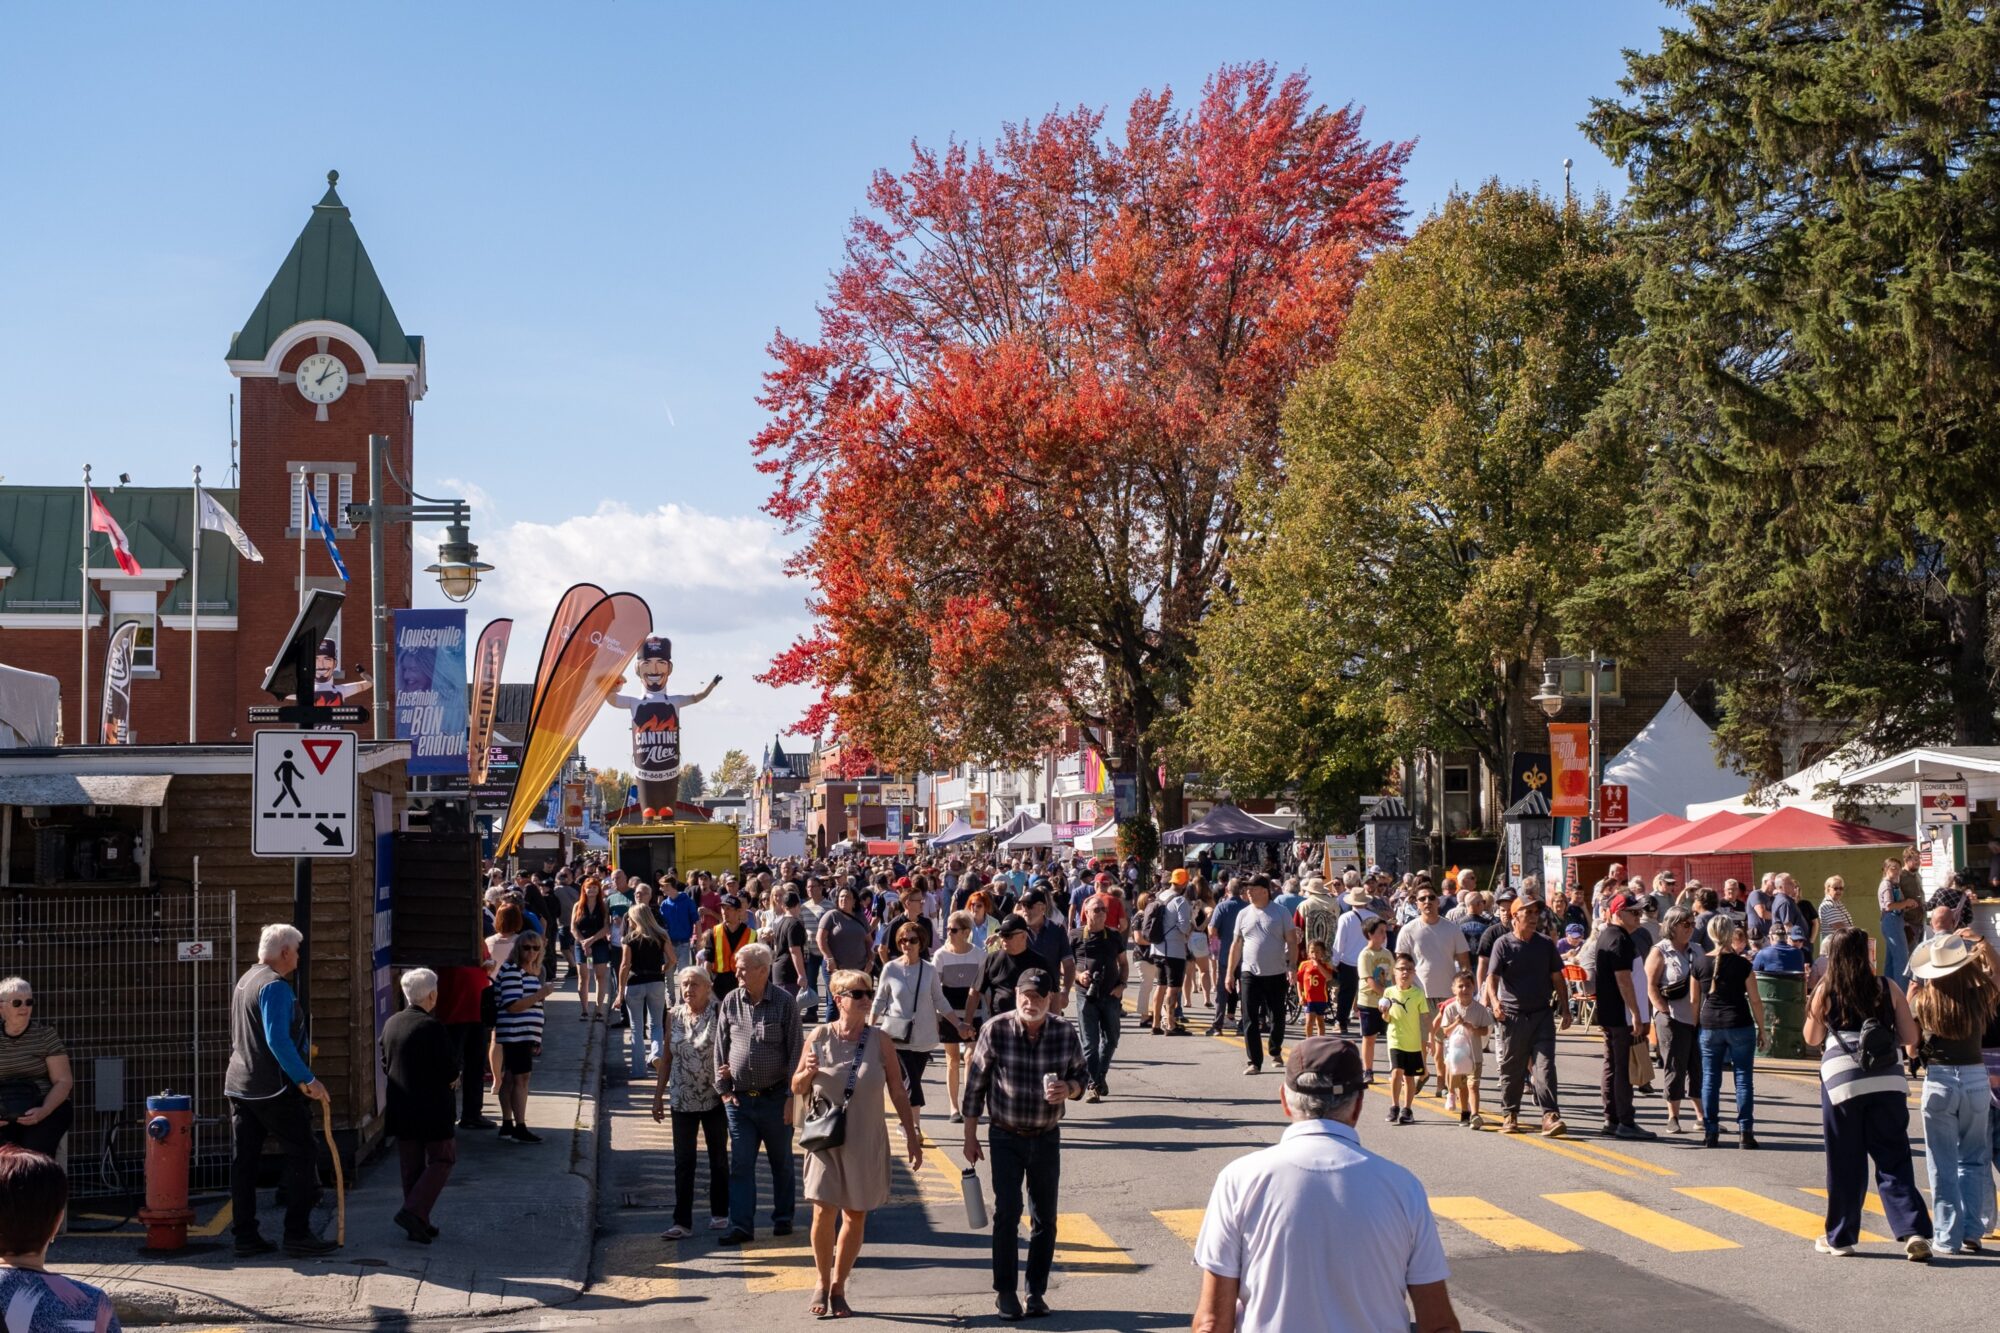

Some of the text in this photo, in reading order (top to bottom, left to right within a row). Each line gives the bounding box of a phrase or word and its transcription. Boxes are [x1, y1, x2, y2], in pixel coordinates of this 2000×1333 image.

[399, 626, 461, 649] Louiseville
[108, 645, 130, 701] Alex
[396, 690, 439, 706] Ensemble
[401, 706, 444, 736] au BON
[417, 732, 465, 756] endroit
[635, 731, 678, 745] CANTINE
[641, 745, 676, 765] Alex
[1309, 975, 1319, 986] 16
